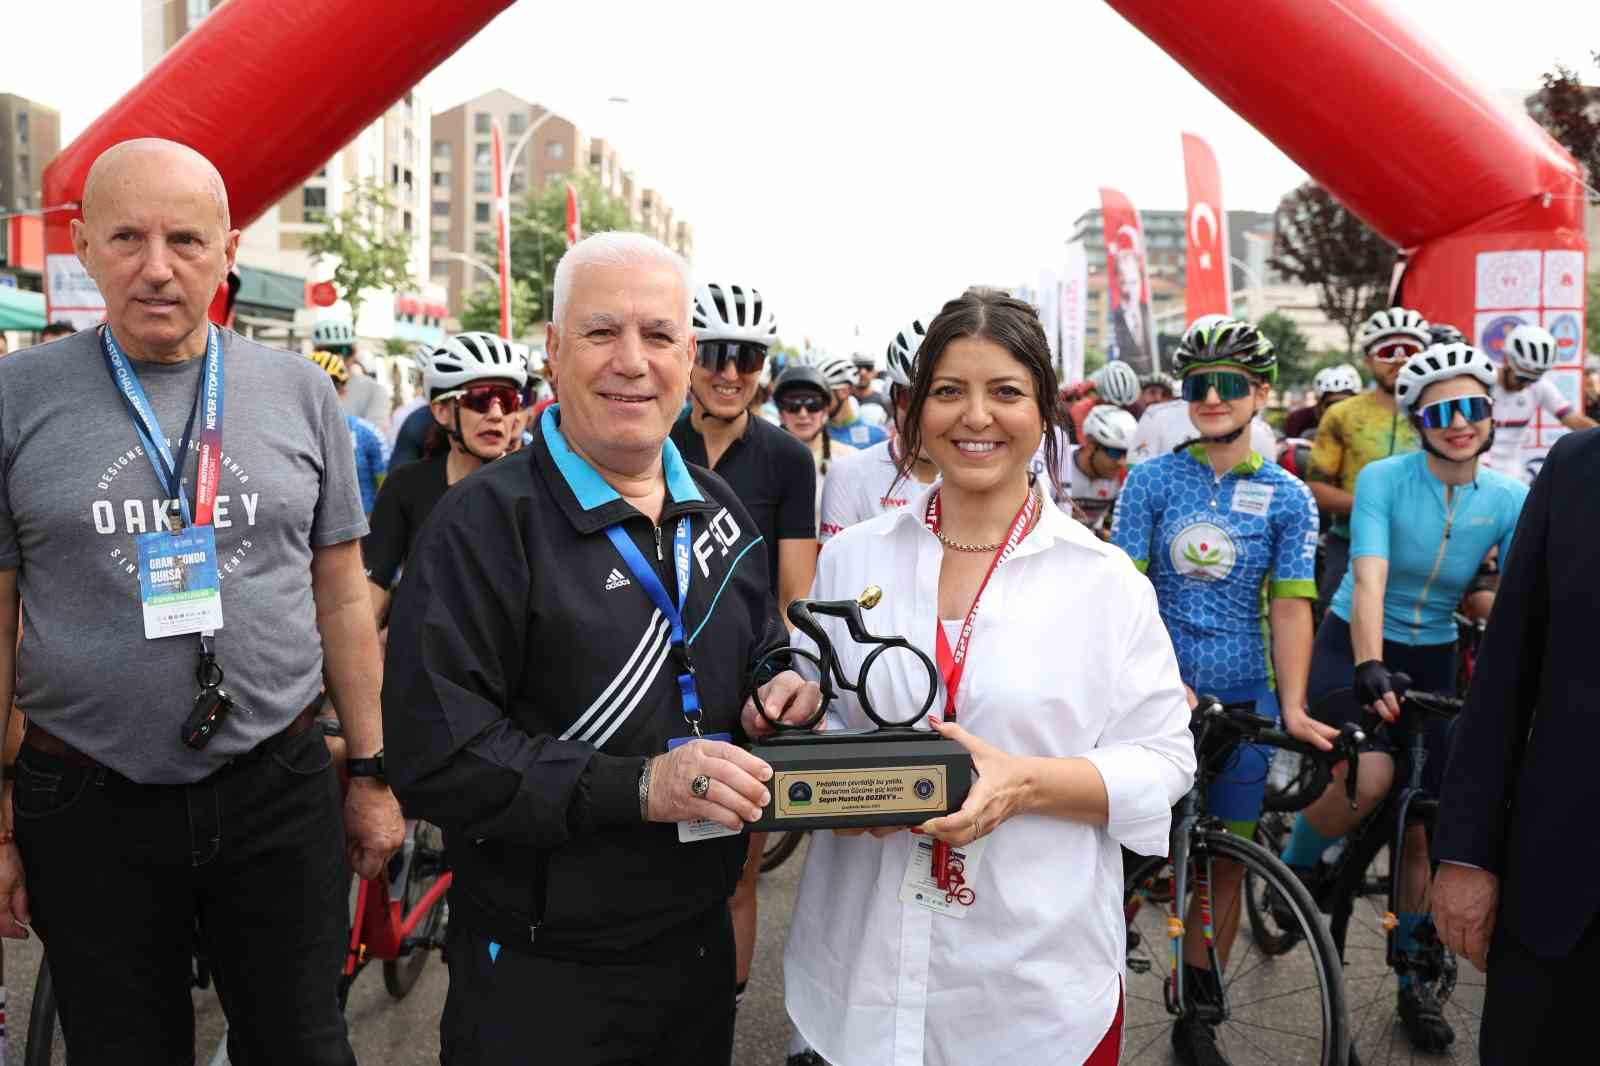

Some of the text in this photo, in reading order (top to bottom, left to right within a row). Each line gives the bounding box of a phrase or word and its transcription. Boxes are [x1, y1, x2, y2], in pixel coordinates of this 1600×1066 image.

[207, 374, 218, 399] STOP
[205, 397, 217, 431] NEVER
[97, 445, 145, 490] DESIGNE
[92, 493, 259, 535] OAKEY
[150, 567, 182, 584] BURSA
[605, 578, 631, 591] adidas
